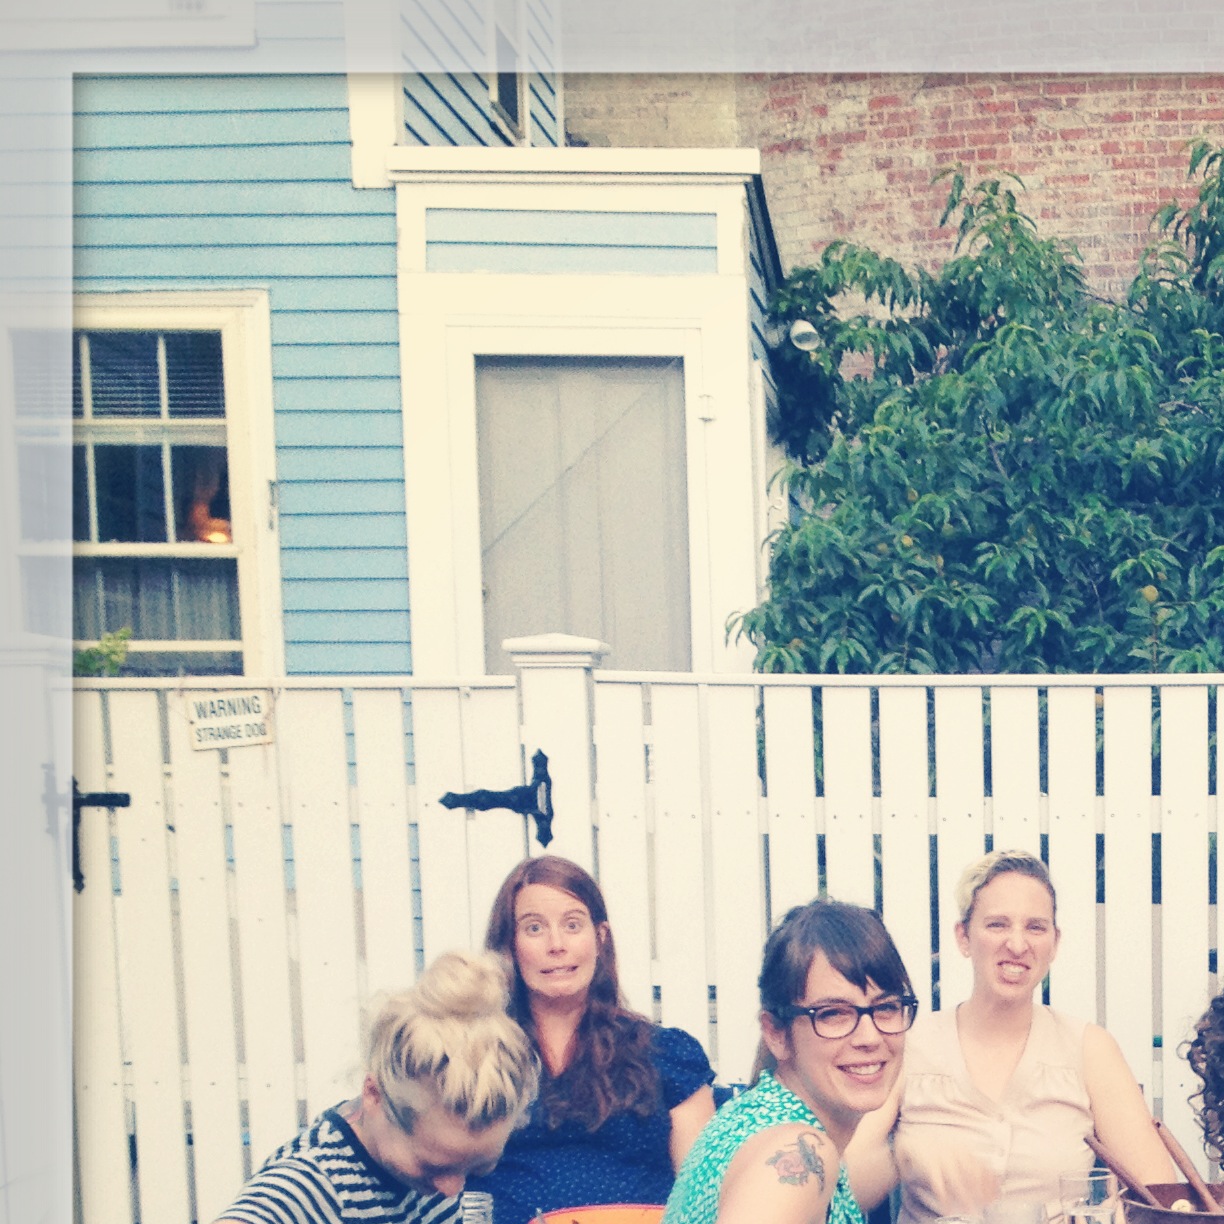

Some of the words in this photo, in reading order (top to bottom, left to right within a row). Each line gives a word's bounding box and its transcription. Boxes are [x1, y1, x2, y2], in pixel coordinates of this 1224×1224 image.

[193, 695, 261, 719] WARNING
[196, 724, 243, 742] STRANGE
[245, 723, 267, 738] DOG
